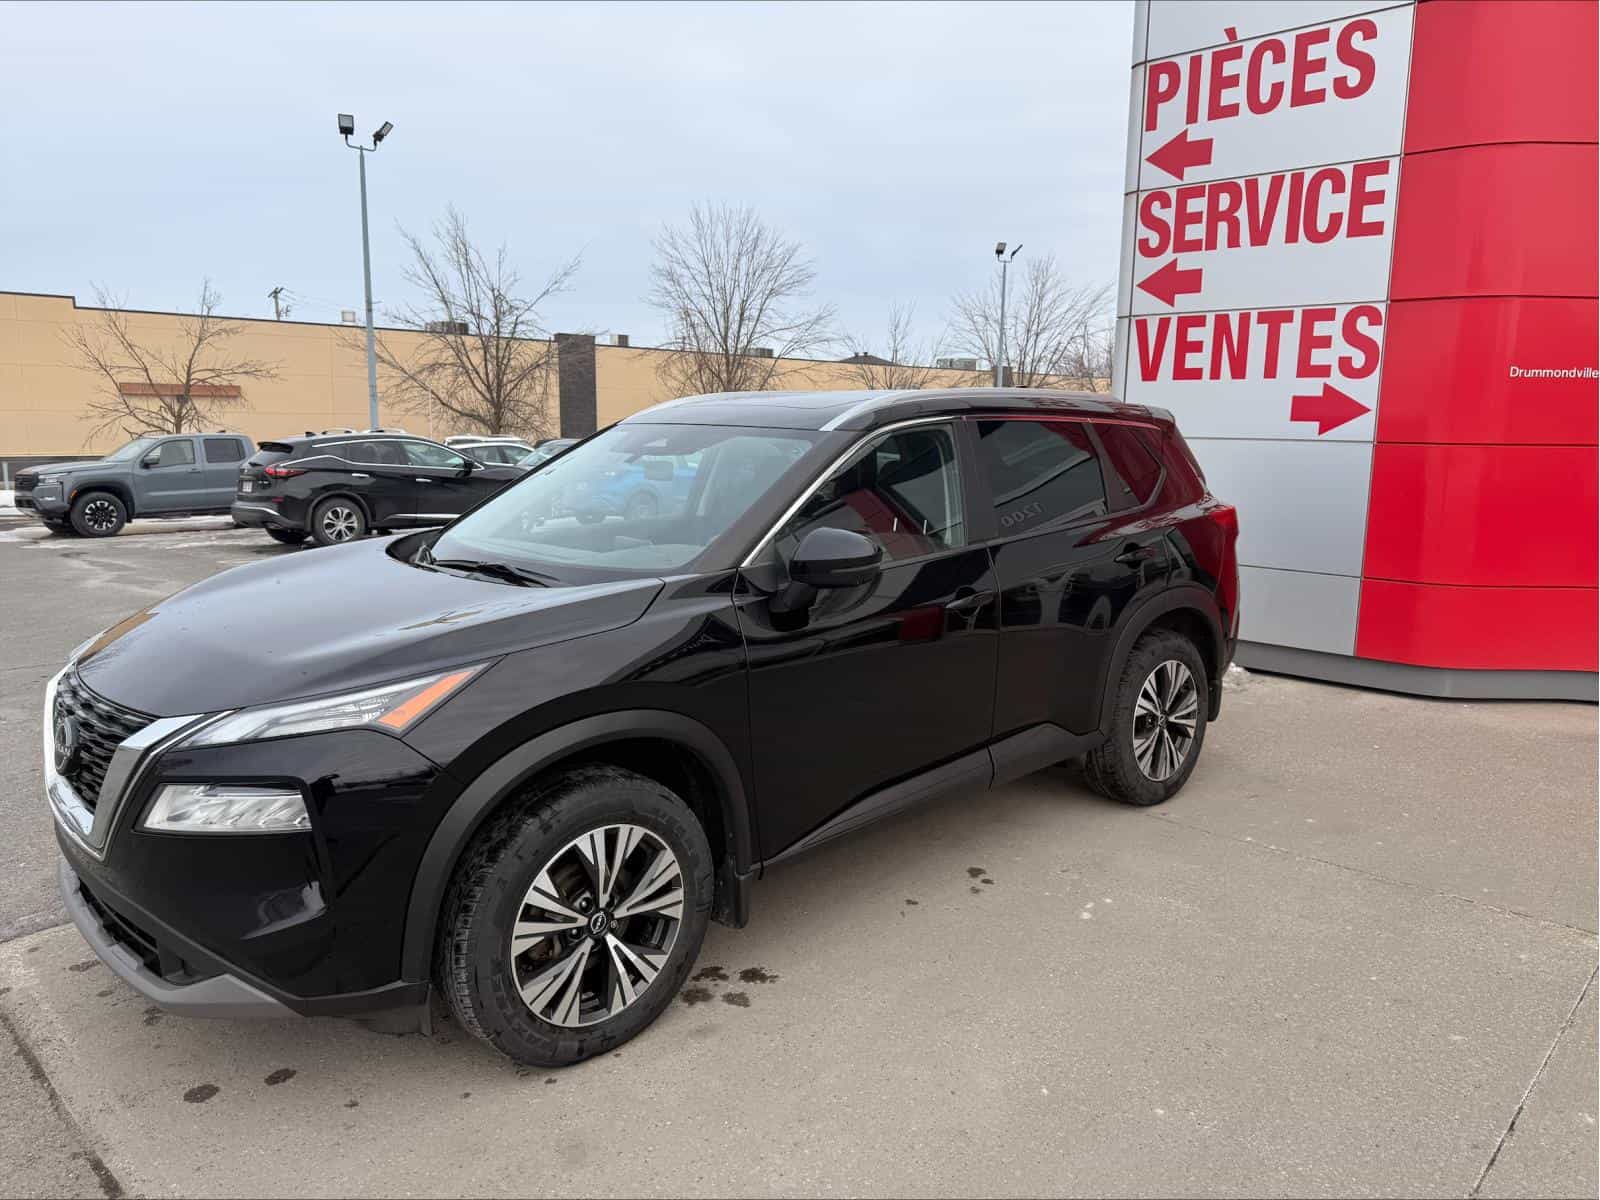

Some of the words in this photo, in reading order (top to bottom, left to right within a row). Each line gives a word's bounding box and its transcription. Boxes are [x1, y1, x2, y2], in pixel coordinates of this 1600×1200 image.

[1145, 18, 1378, 132] PIÈCES
[1138, 160, 1390, 259] SERVICE
[1135, 304, 1384, 382] VENTES
[1509, 365, 1599, 378] Drummondville
